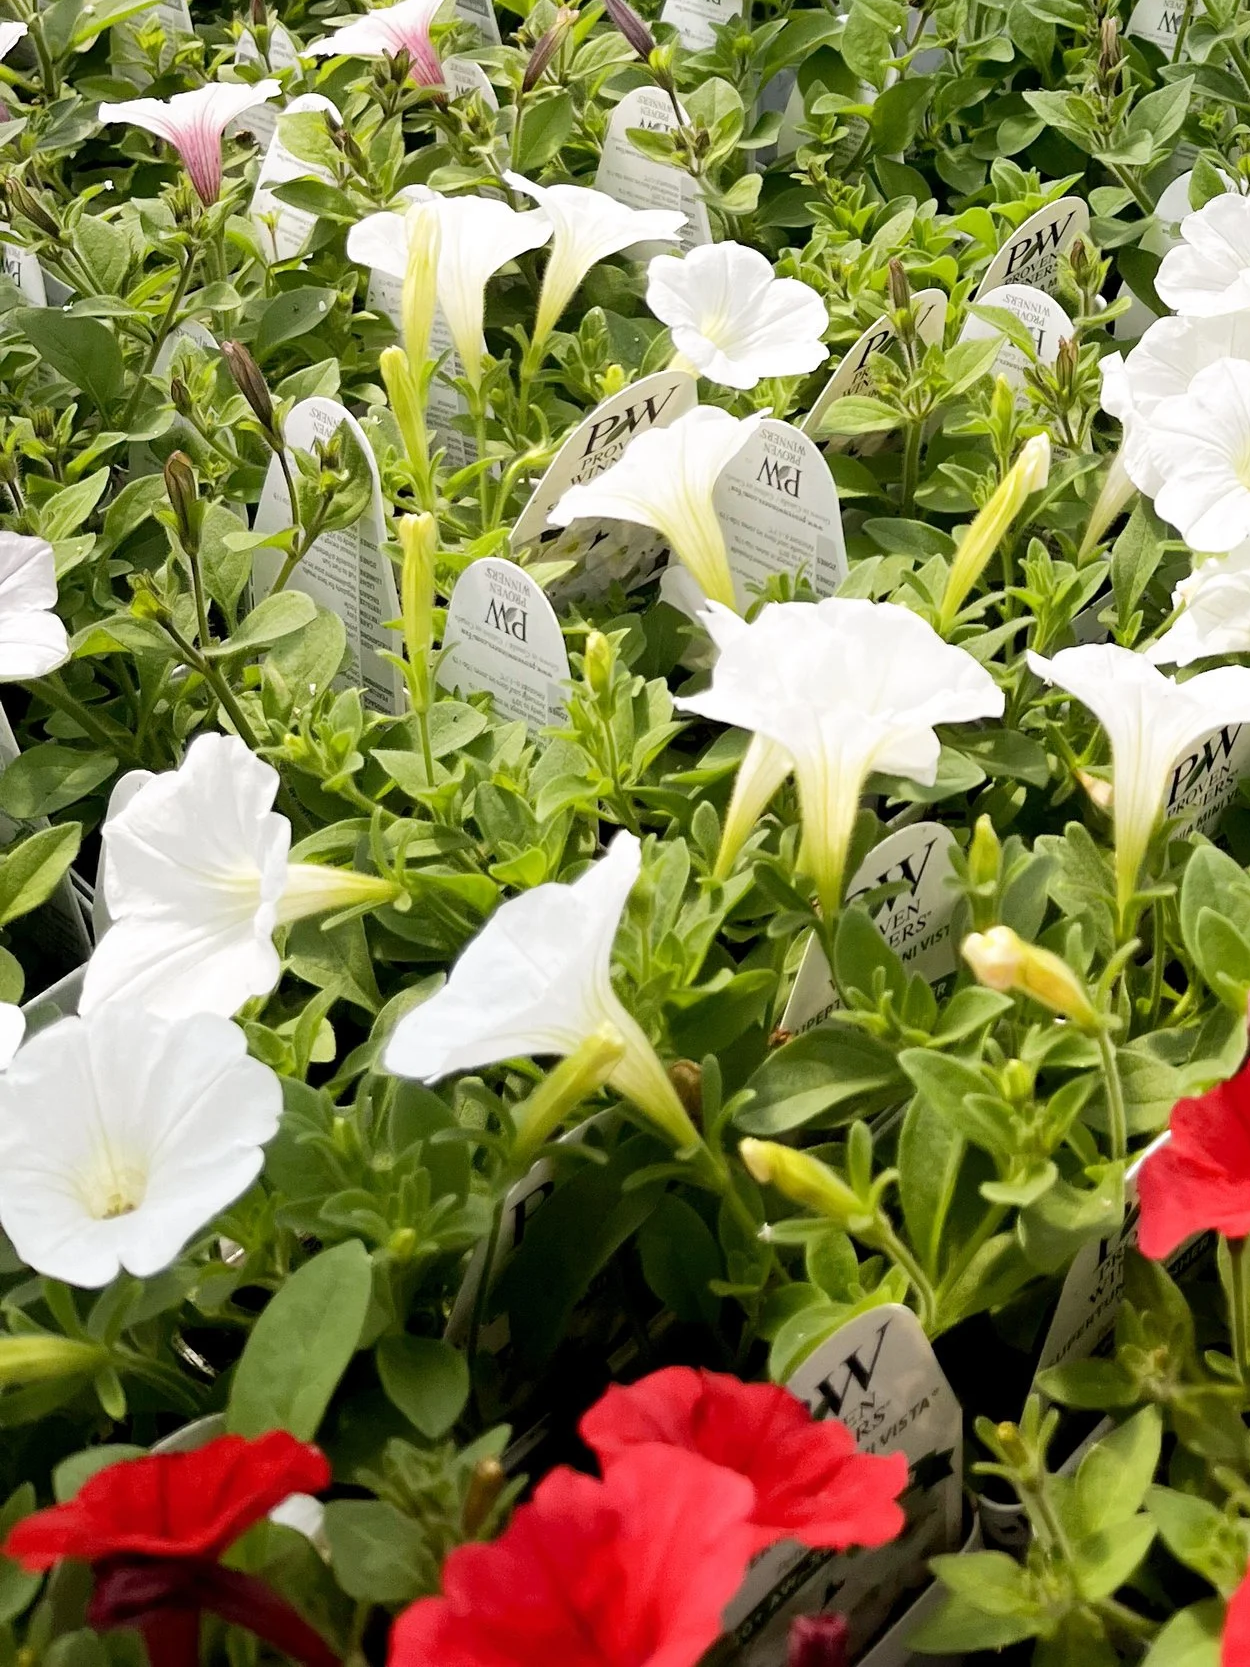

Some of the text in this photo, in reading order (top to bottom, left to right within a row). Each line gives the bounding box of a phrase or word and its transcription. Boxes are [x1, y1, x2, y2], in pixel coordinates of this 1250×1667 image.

[1003, 209, 1077, 279] PW
[579, 382, 682, 460] PW
[761, 428, 806, 457] WINNERS
[763, 443, 802, 466] PROVEN
[756, 456, 803, 499] PW
[484, 567, 531, 598] WINNERS
[489, 582, 527, 609] PROVEN
[484, 597, 528, 643] PW
[1167, 722, 1243, 808] PW
[920, 924, 950, 952] VIST
